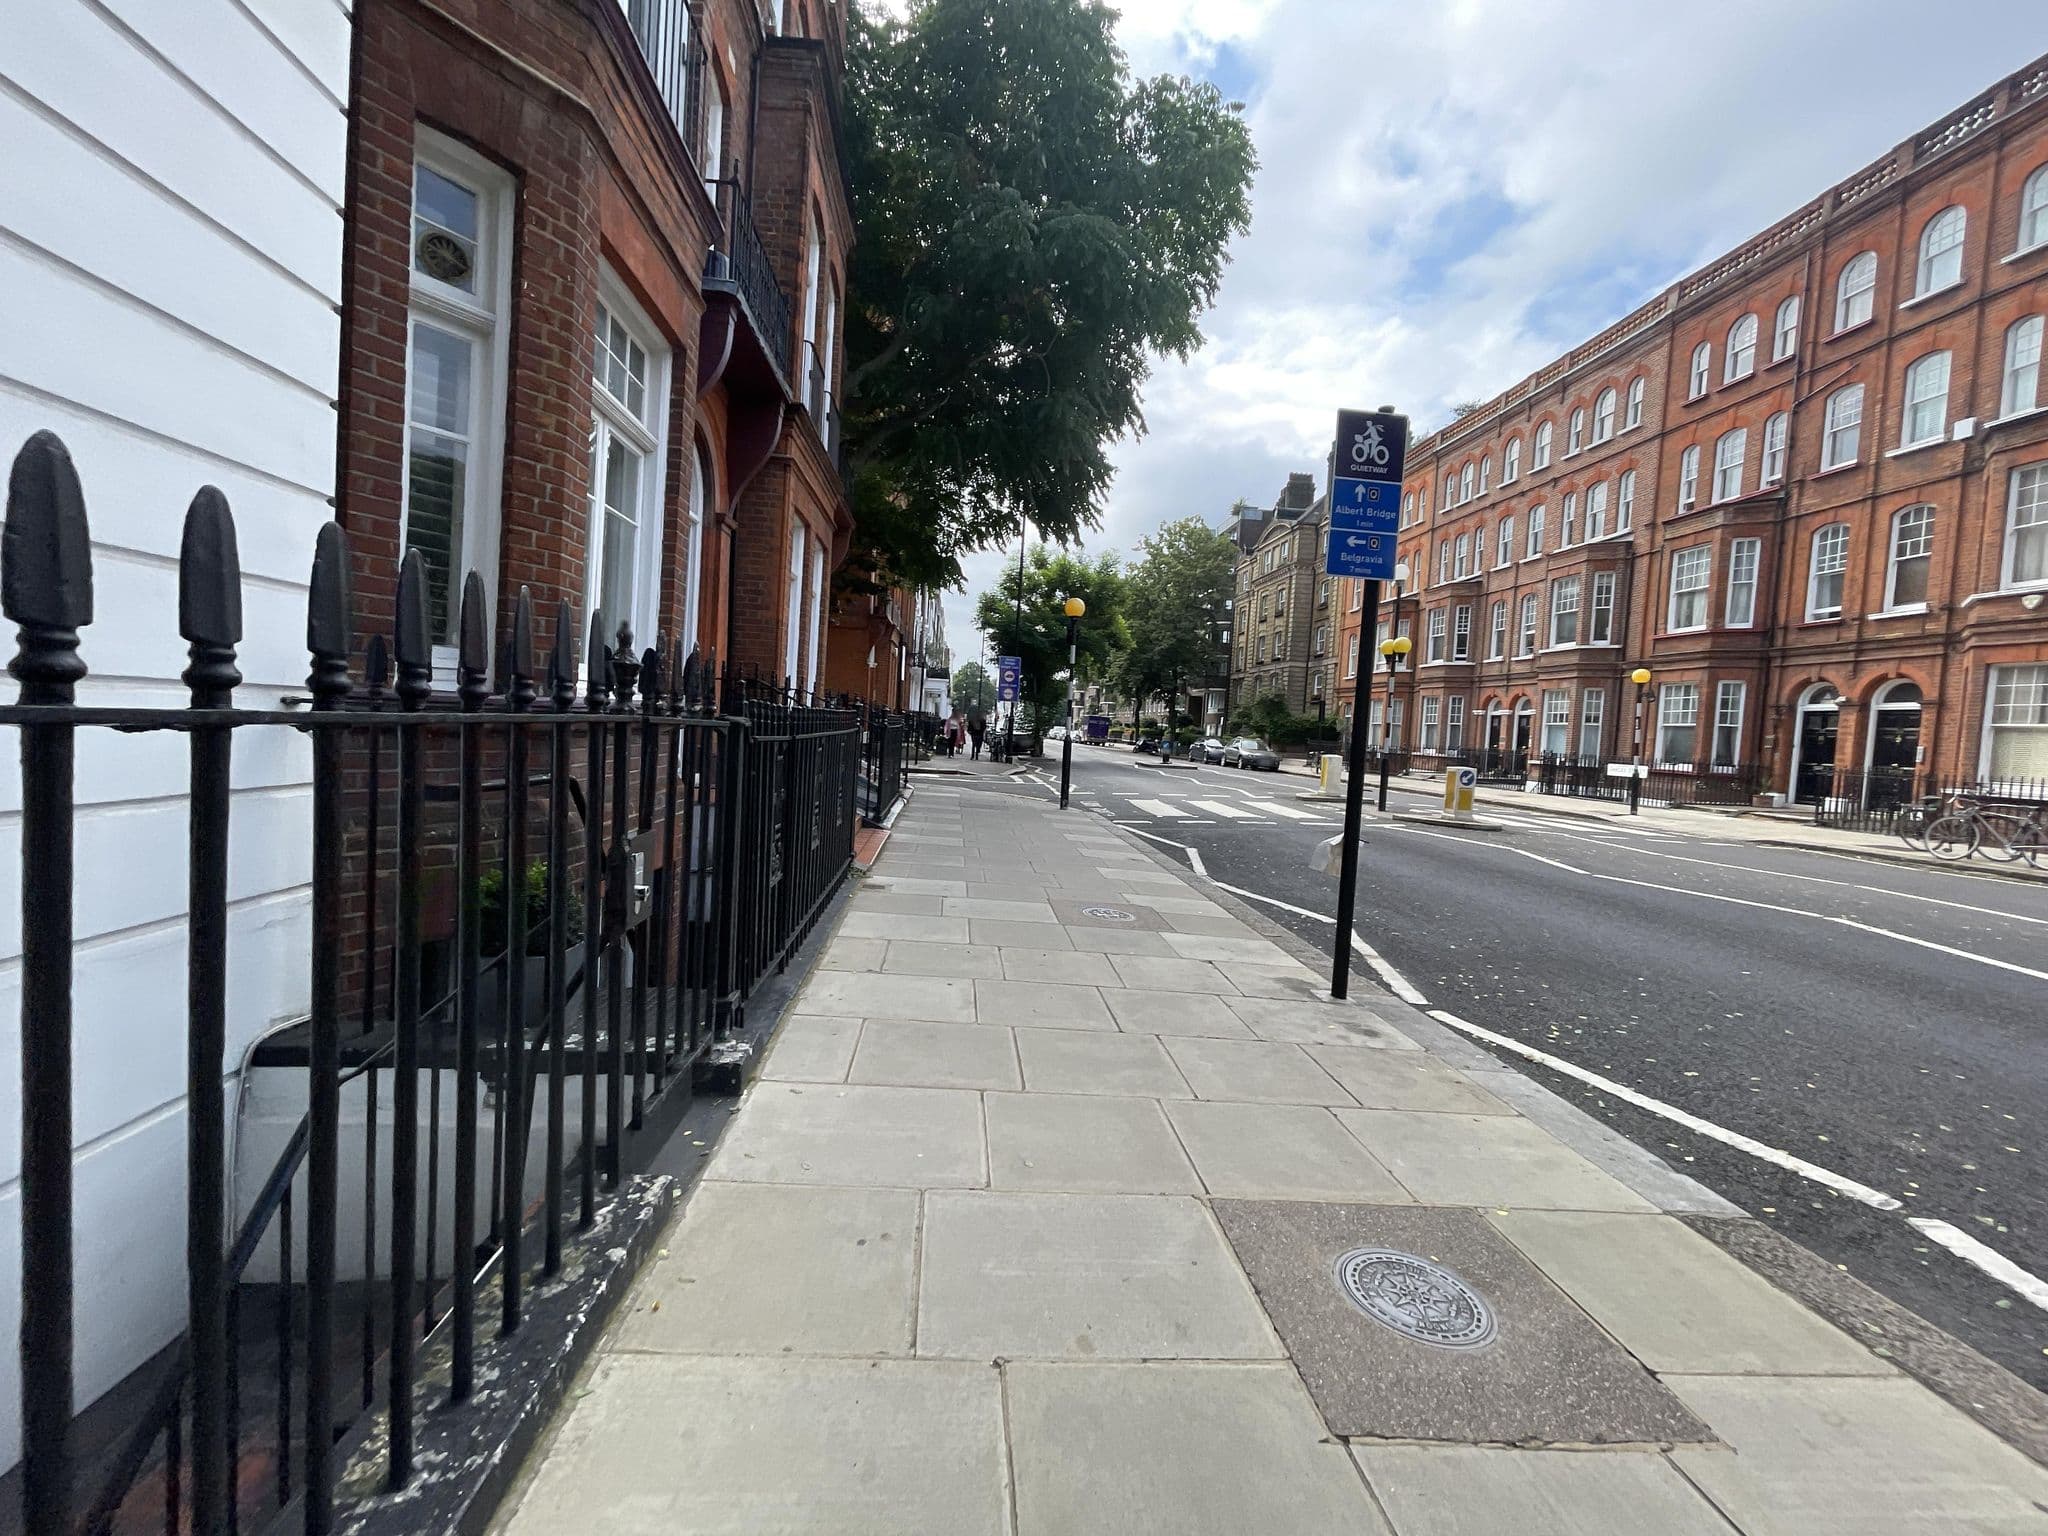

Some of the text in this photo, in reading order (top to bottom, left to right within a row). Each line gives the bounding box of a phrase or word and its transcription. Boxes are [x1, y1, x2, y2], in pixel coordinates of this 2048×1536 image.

[1335, 504, 1396, 519] Albert Bridge
[1340, 552, 1383, 564] Belgravia
